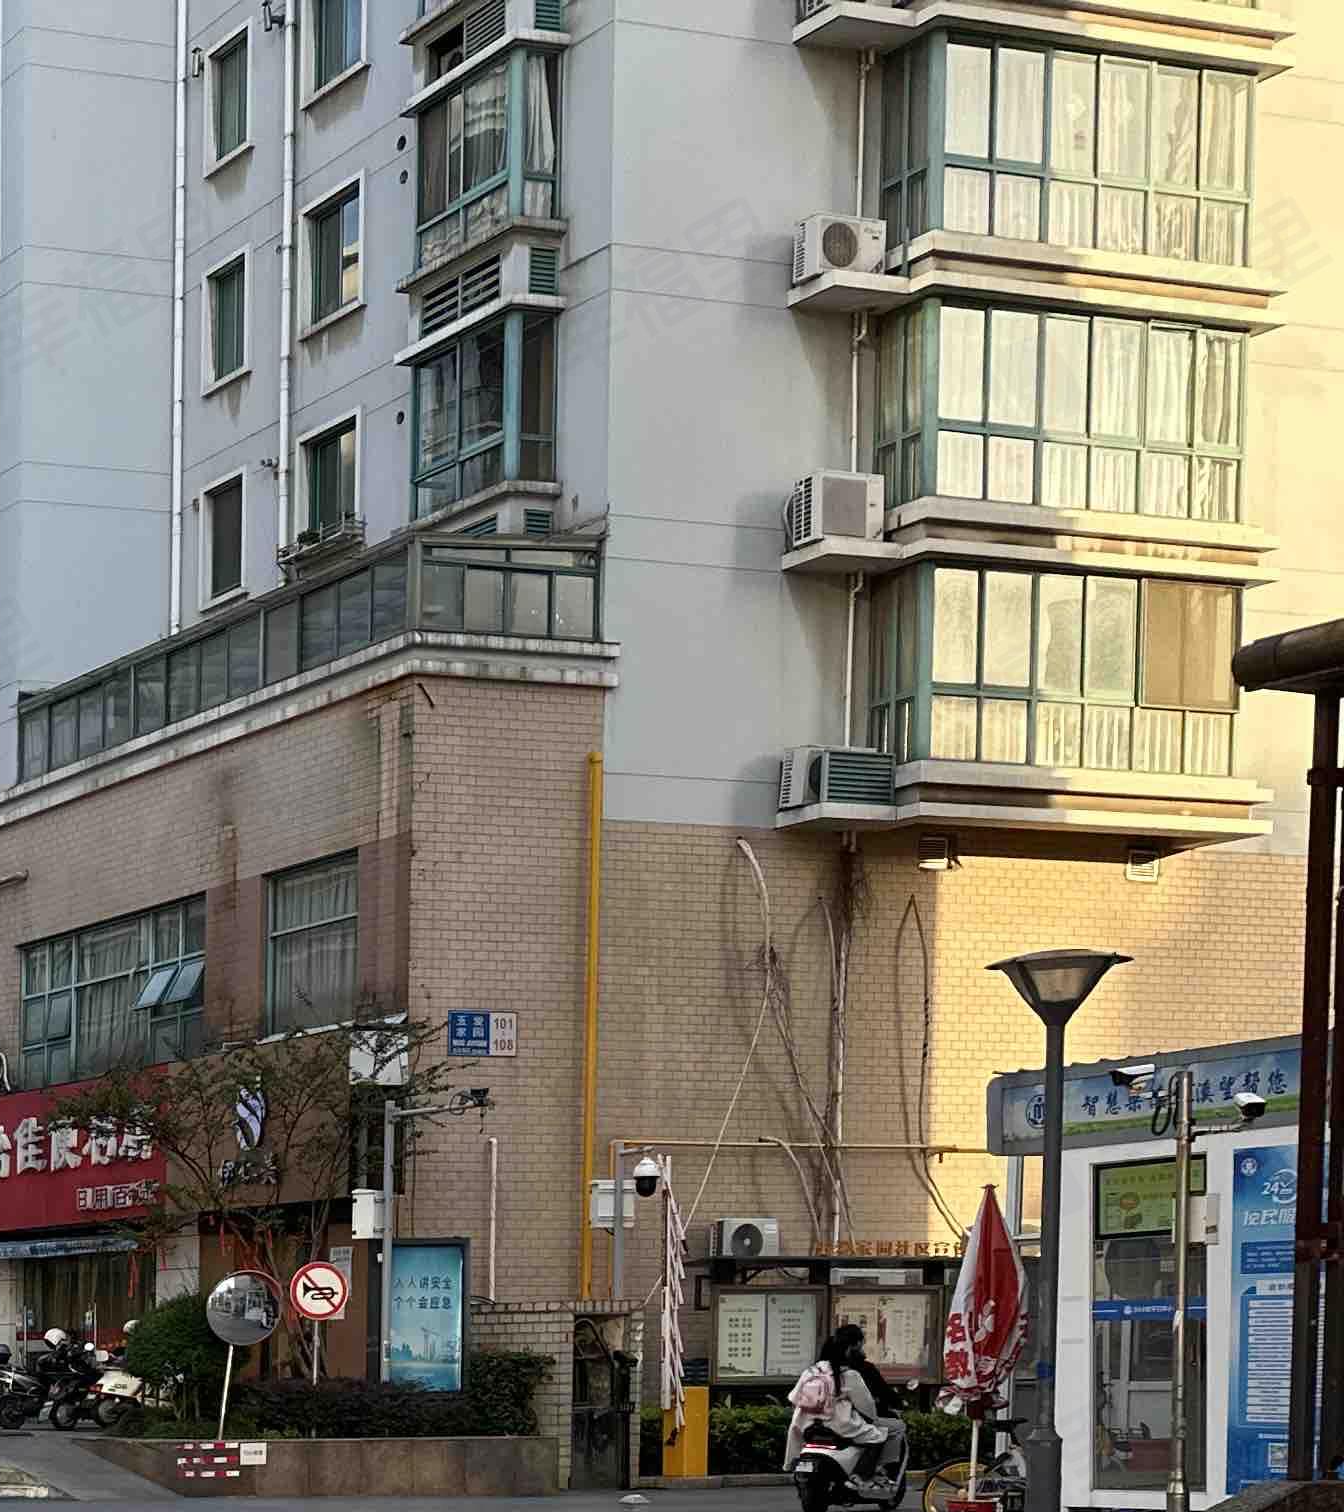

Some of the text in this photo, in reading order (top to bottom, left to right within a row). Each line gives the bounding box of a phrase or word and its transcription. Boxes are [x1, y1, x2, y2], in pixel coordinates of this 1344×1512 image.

[495, 1018, 513, 1029] 101
[495, 1039, 513, 1051] 108
[392, 1276, 452, 1290] 人人讲安全
[392, 1296, 452, 1310] 个个会应急
